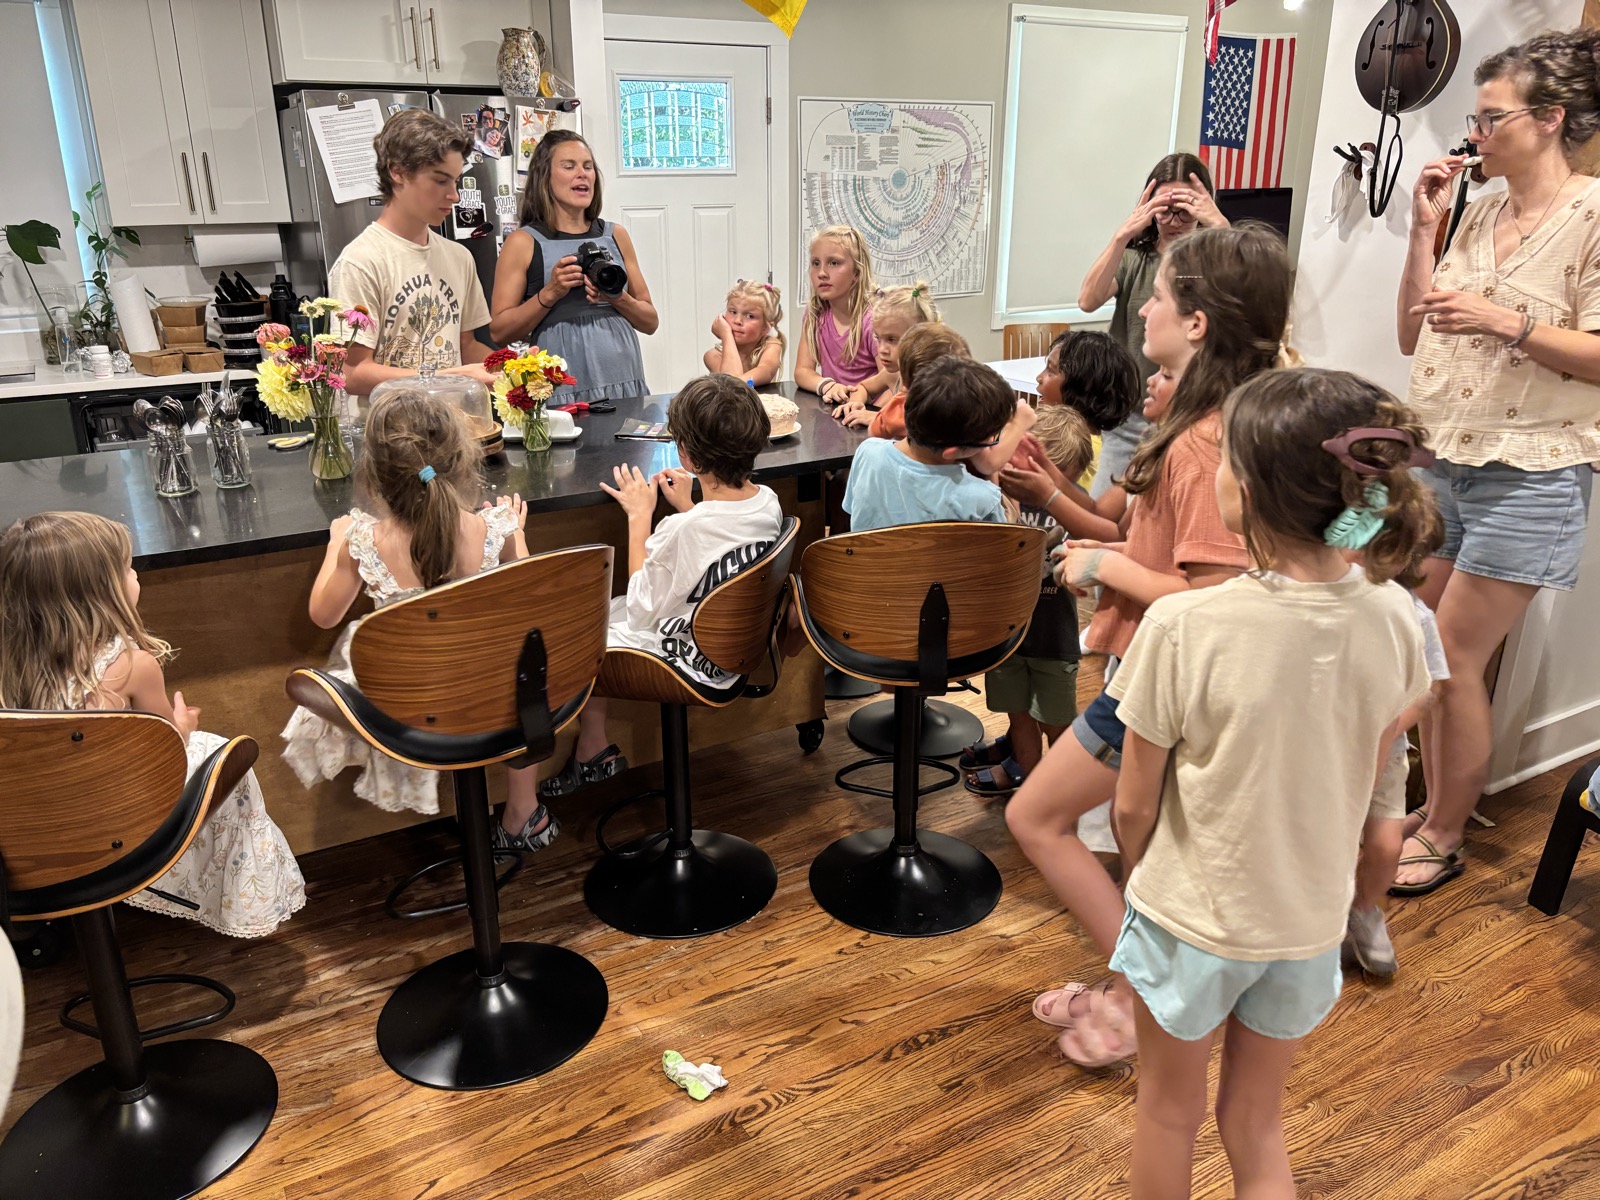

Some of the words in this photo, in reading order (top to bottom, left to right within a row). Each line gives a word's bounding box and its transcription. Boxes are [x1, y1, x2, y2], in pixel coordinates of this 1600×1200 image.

[865, 109, 878, 117] History
[459, 189, 481, 200] YOUTH
[464, 200, 481, 208] GRACE
[495, 196, 516, 207] YOUTH
[384, 273, 432, 329] JOSHUA
[438, 278, 460, 325] TREE
